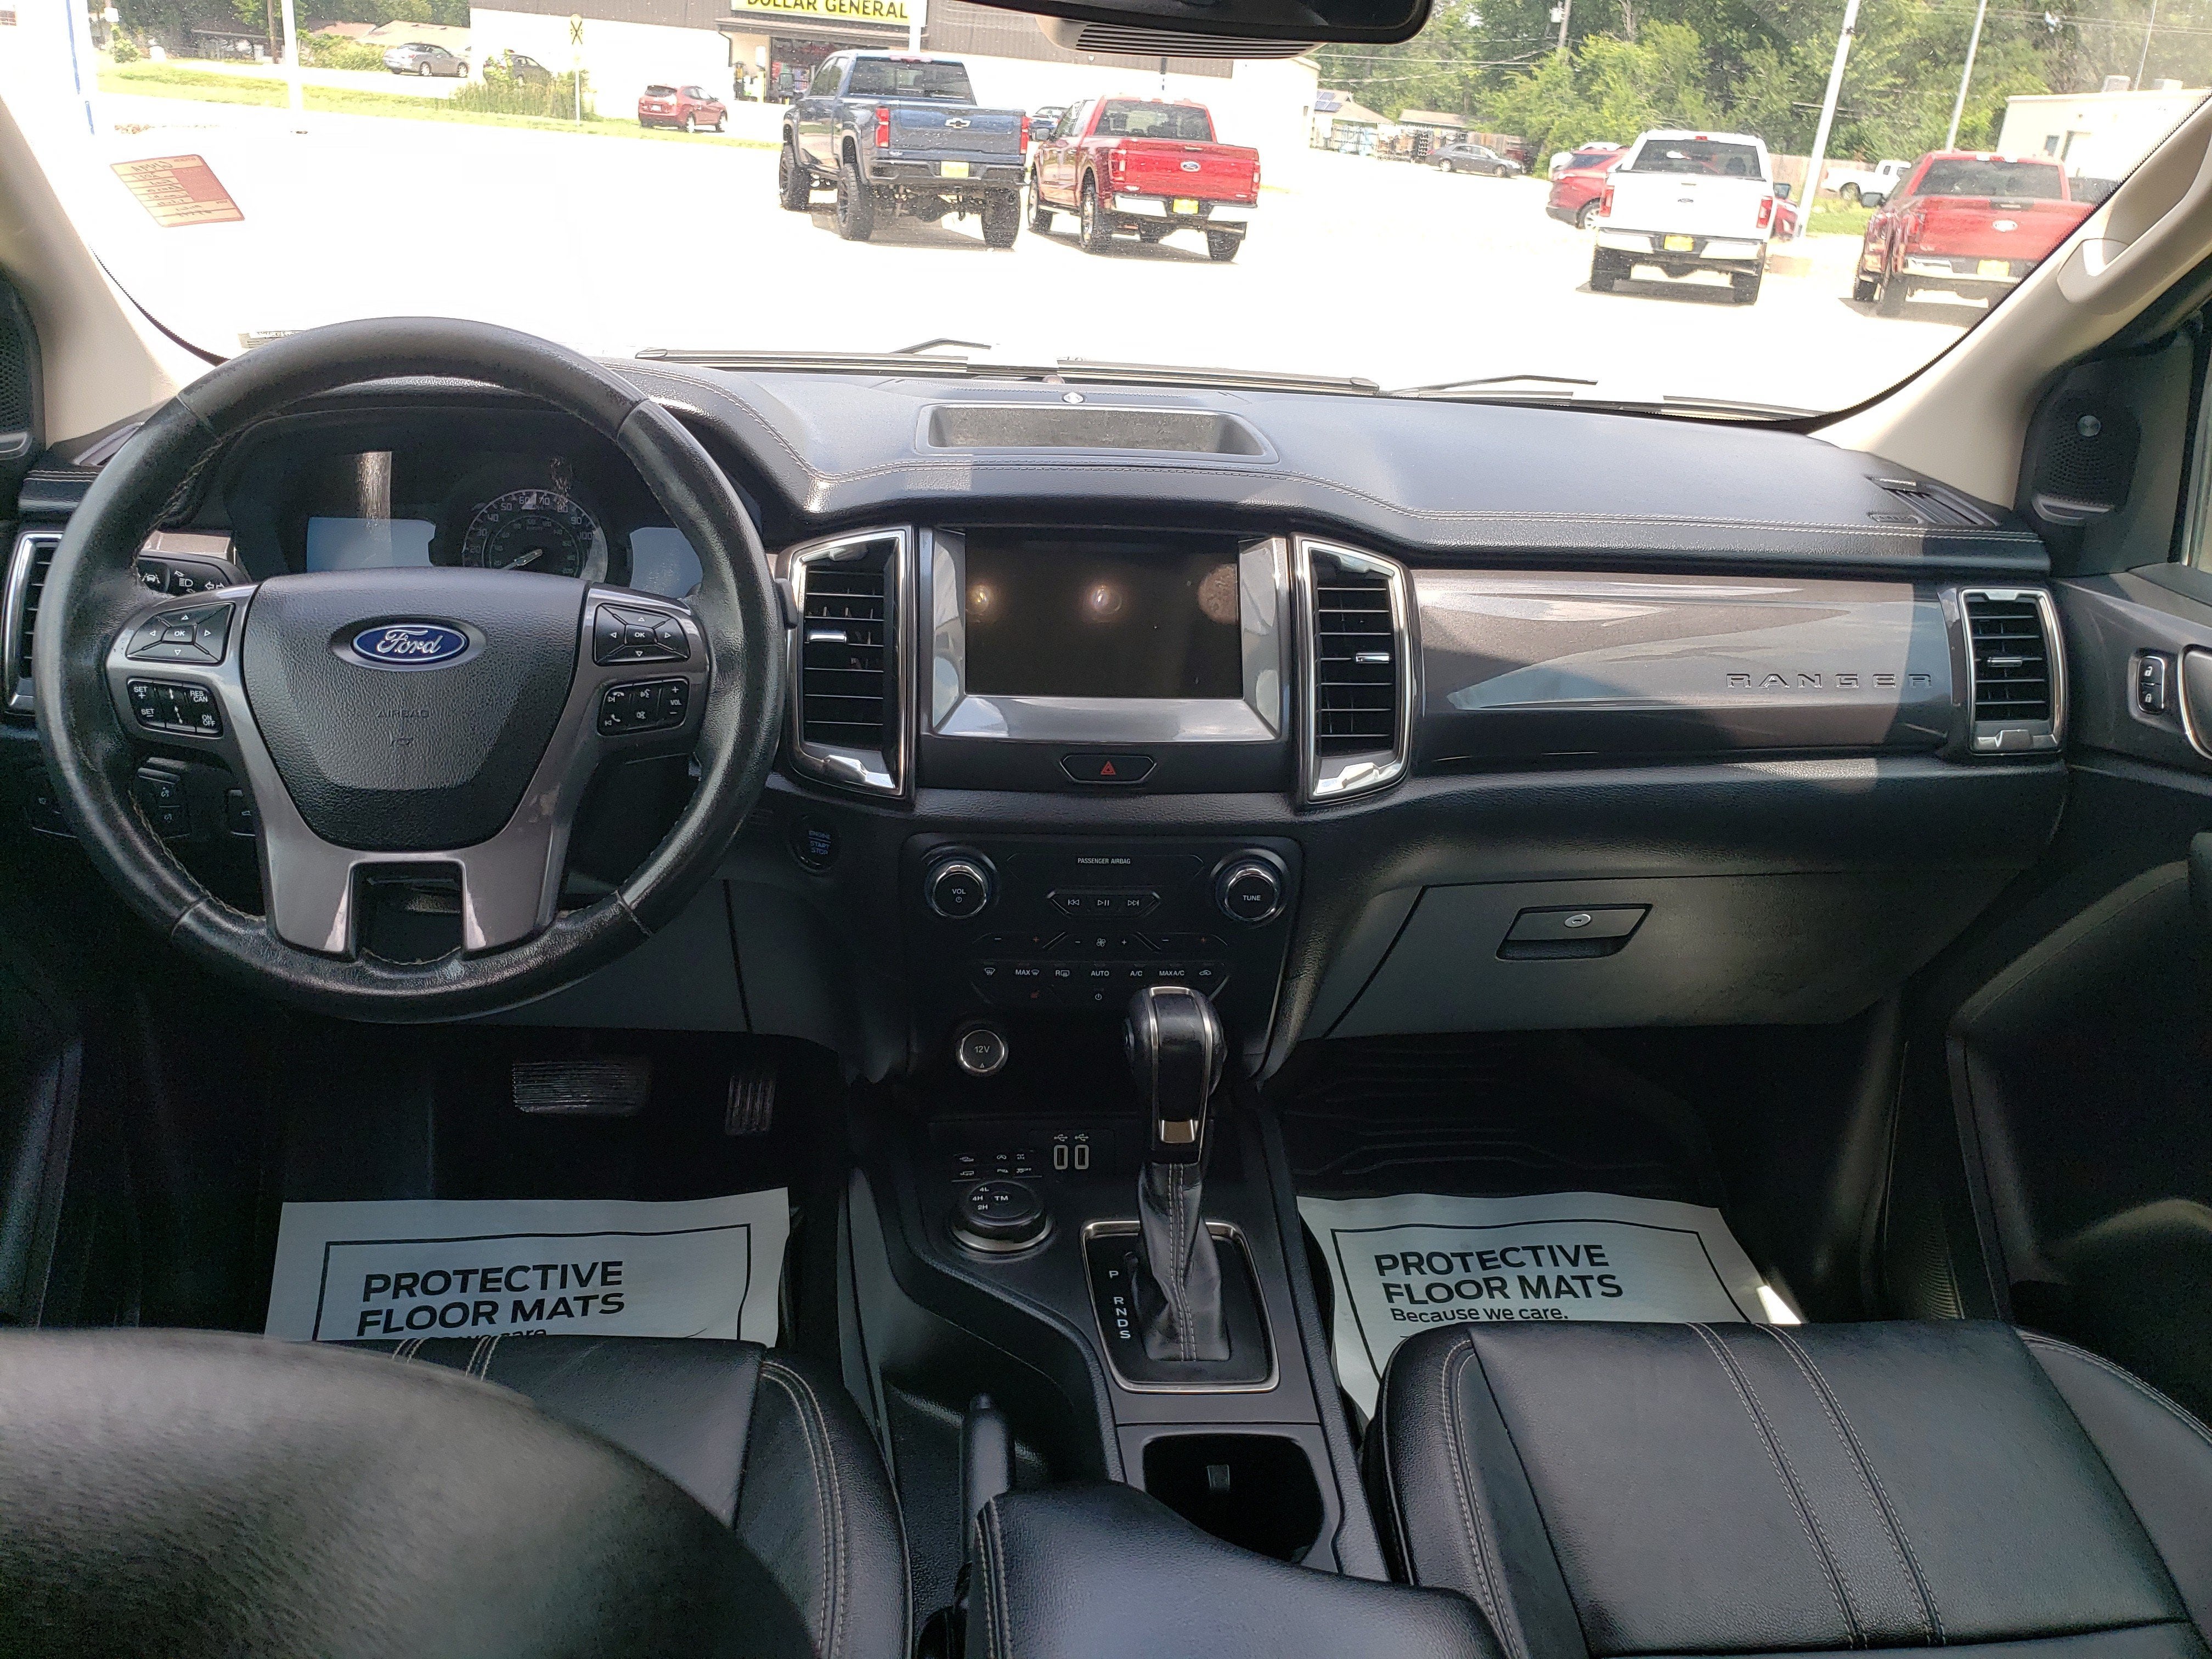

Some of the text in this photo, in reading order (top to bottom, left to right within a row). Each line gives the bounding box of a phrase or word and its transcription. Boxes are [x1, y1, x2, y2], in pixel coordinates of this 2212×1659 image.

[748, 0, 907, 19] LAR GENERAL
[501, 503, 513, 511] 50
[487, 514, 499, 522] 40
[571, 516, 583, 525] 90
[579, 531, 594, 540] 100
[377, 629, 443, 653] Ford
[1726, 673, 1931, 688] RANGER
[1374, 1244, 1610, 1277] PROTECTIVE
[1109, 1270, 1119, 1279] P
[363, 1261, 623, 1302] PROTECTIVE
[1381, 1274, 1624, 1306] FLOOR MATS
[1113, 1296, 1124, 1305] R
[357, 1292, 625, 1338] FLOOR MATS
[1115, 1307, 1127, 1316] N
[1390, 1307, 1569, 1323] Because we care.
[1117, 1319, 1128, 1328] D
[1119, 1330, 1131, 1339] S
